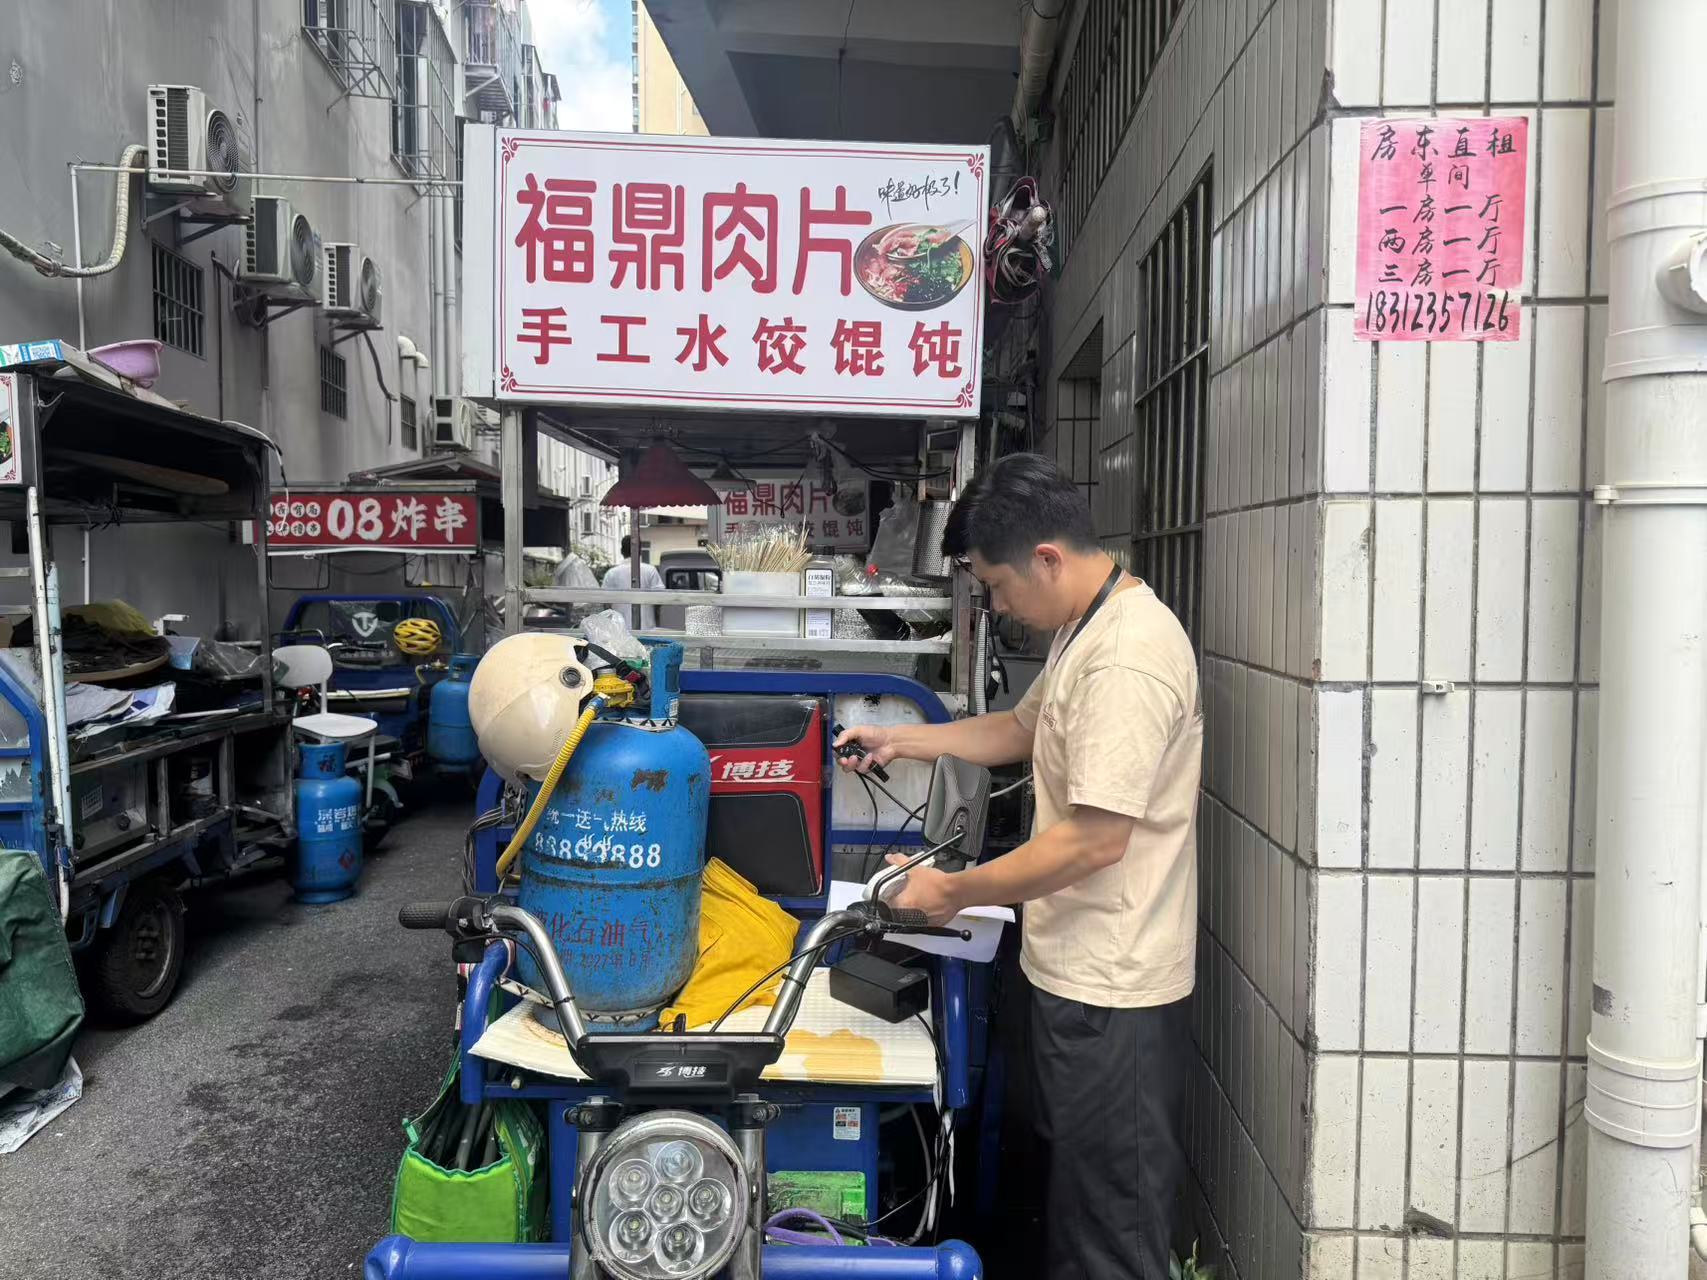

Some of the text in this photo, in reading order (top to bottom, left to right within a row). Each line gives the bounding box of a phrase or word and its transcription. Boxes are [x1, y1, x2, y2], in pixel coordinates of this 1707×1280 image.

[1371, 125, 1517, 161] 房东直租
[1417, 163, 1470, 192] 单间
[1379, 194, 1504, 223] 一房一厅
[515, 172, 872, 296] 福鼎肉片
[1378, 226, 1502, 255] 两房一厅
[1378, 258, 1501, 287] 三房一厅
[1365, 290, 1510, 334] 18312357126
[516, 306, 963, 379] 手工水饺馄饨
[721, 760, 795, 783] 博技
